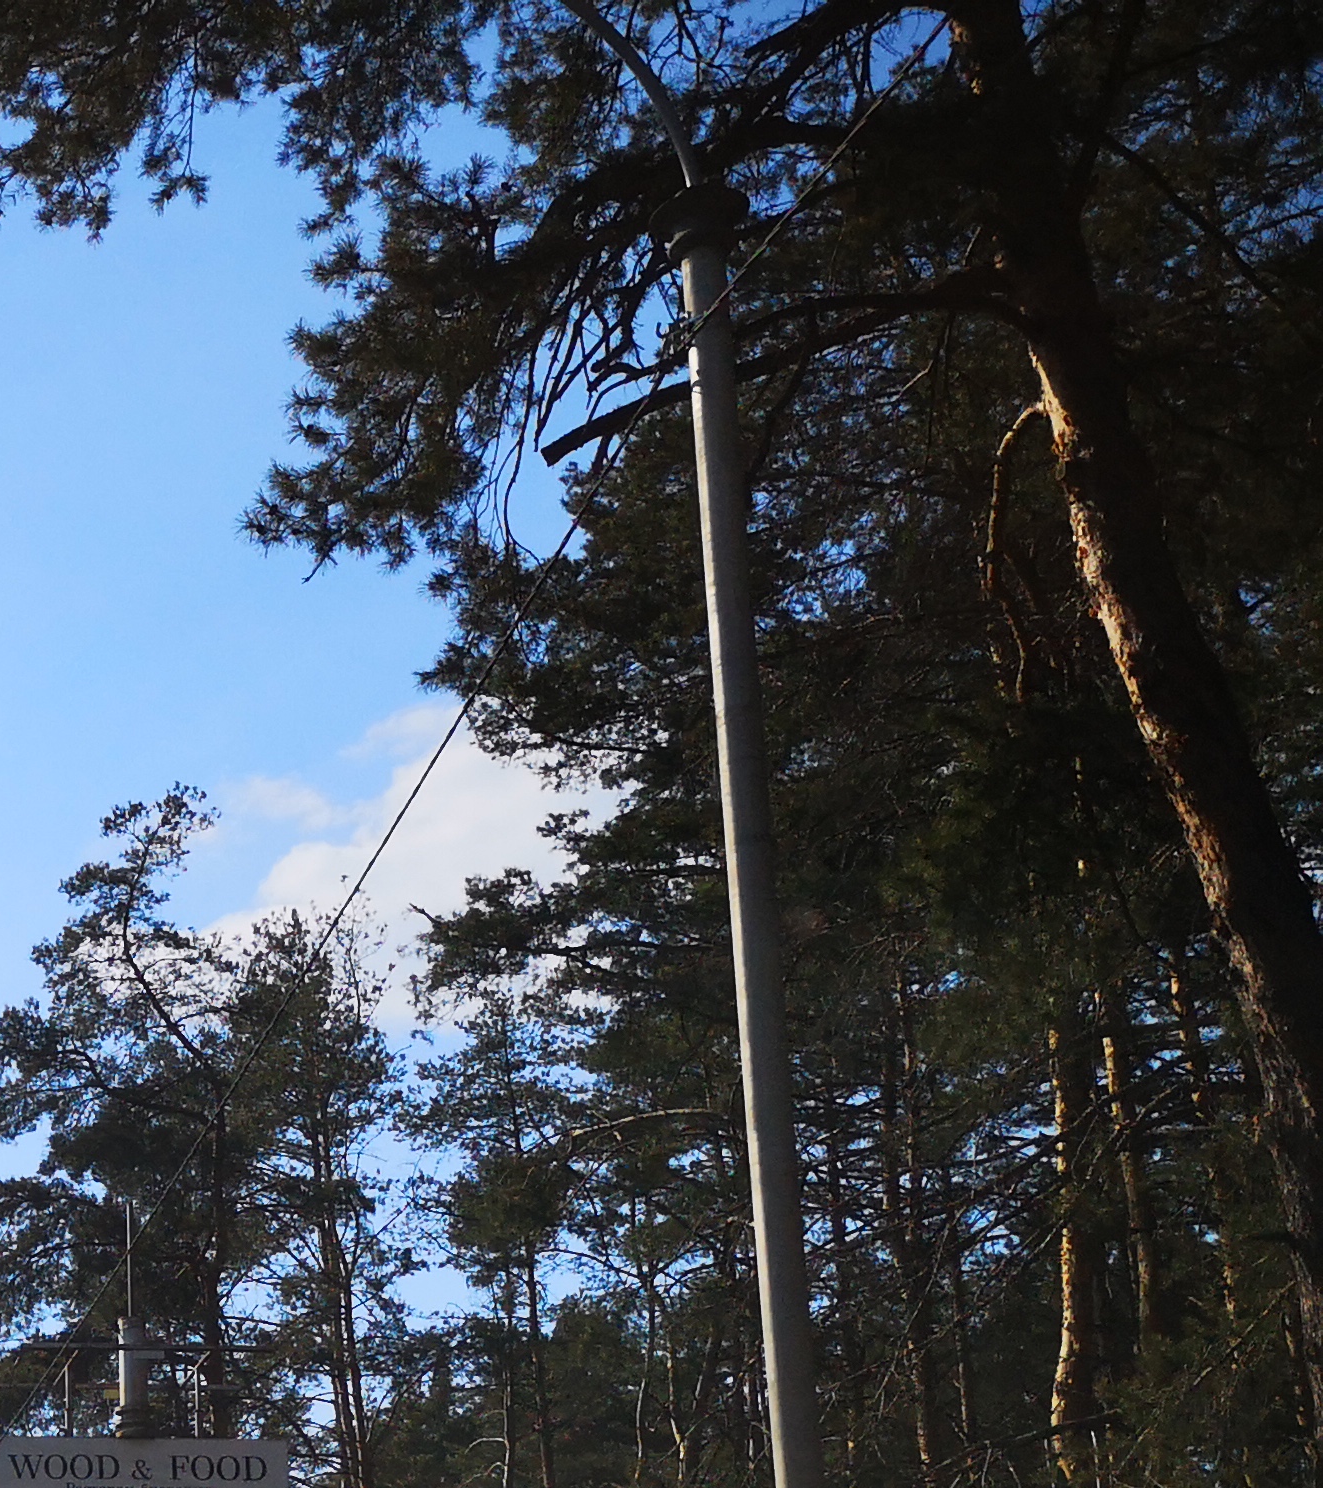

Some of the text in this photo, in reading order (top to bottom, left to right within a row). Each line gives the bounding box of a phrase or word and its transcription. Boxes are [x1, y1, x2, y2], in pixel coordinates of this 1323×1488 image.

[7, 1453, 269, 1483] WOOD & FOOD
